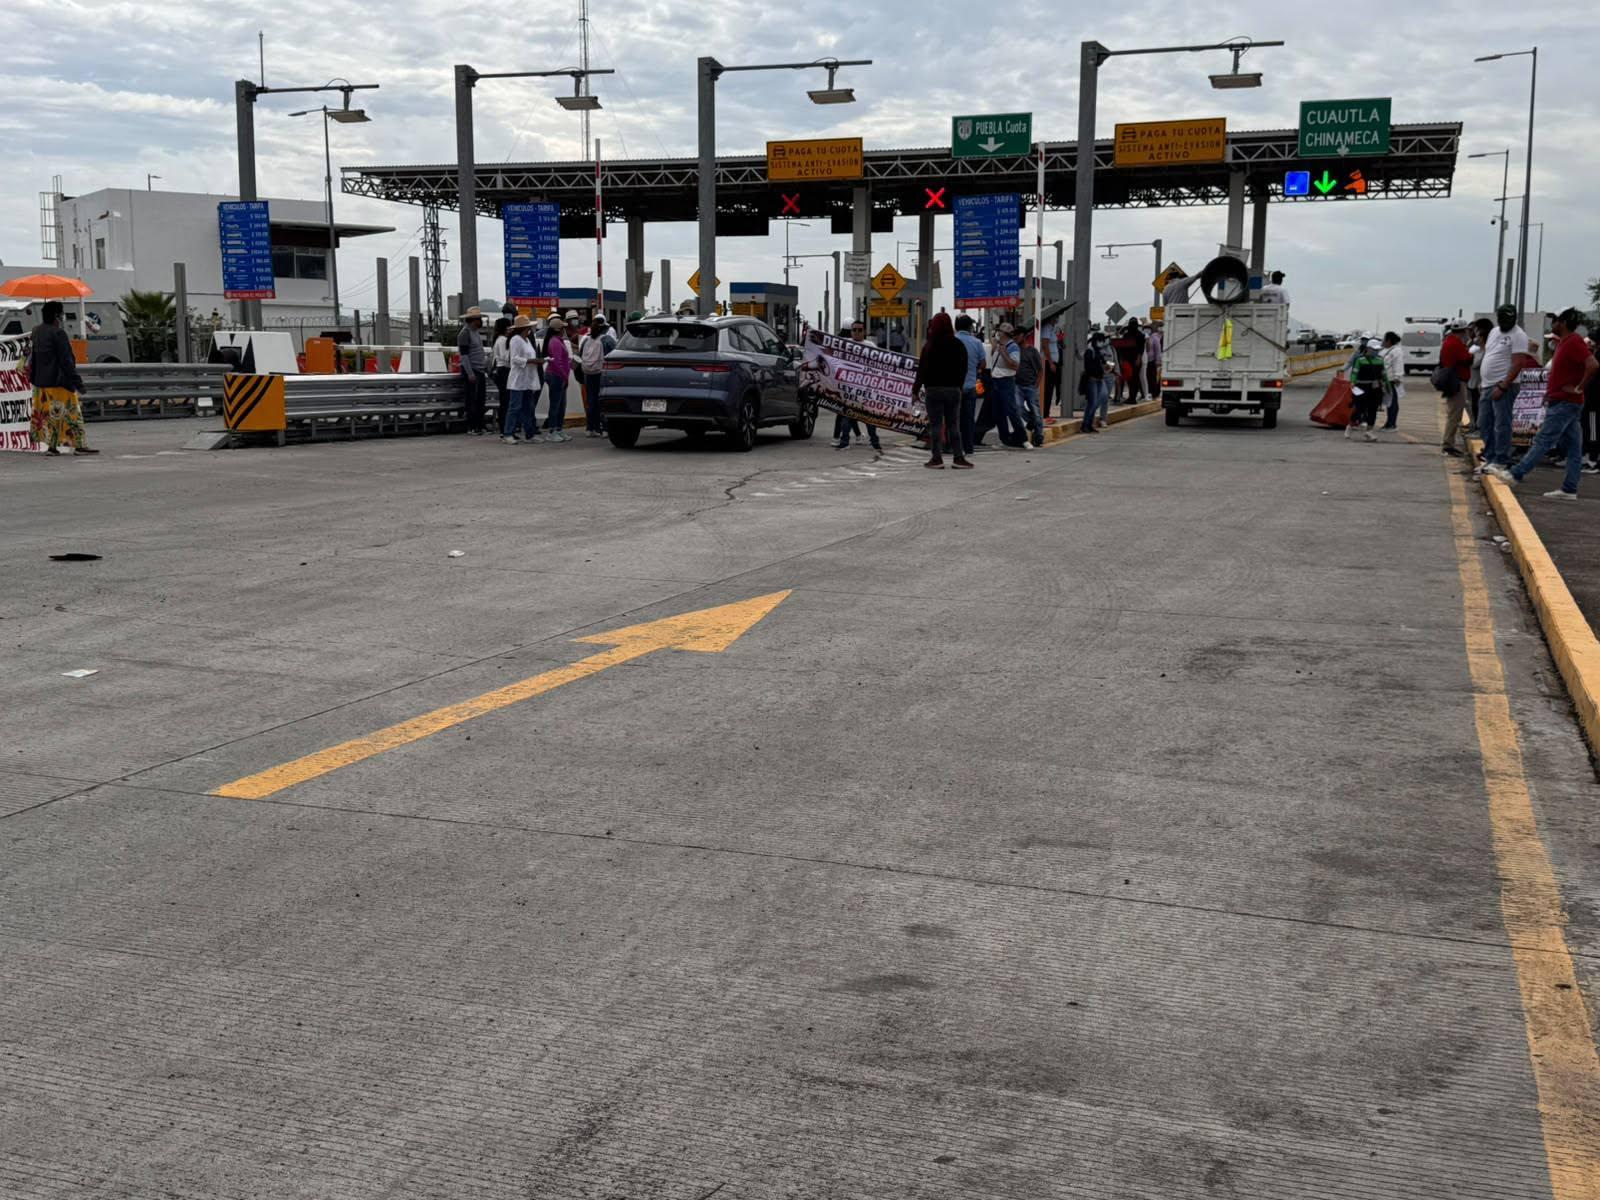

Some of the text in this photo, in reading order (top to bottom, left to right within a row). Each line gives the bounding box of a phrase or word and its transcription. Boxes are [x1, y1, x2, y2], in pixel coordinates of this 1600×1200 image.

[1306, 108, 1380, 125] CUAUTLA
[975, 121, 1003, 136] PUEBLA
[1005, 120, 1027, 134] Cuota
[1141, 127, 1220, 138] PAGA TU CUOTA
[1305, 130, 1380, 147] CHINAMECA
[789, 145, 858, 156] PAGA TU CUOTA
[1118, 144, 1154, 153] SISTEMA
[1148, 151, 1190, 160] ACTIVO
[771, 160, 802, 168] SISTEMA
[796, 168, 832, 176] ACTIVO
[822, 335, 902, 367] DELEGACIÓN
[832, 350, 843, 359] DE
[844, 352, 894, 372] TEPALCINGO
[838, 383, 908, 409] LEY DEL ISSSTE
